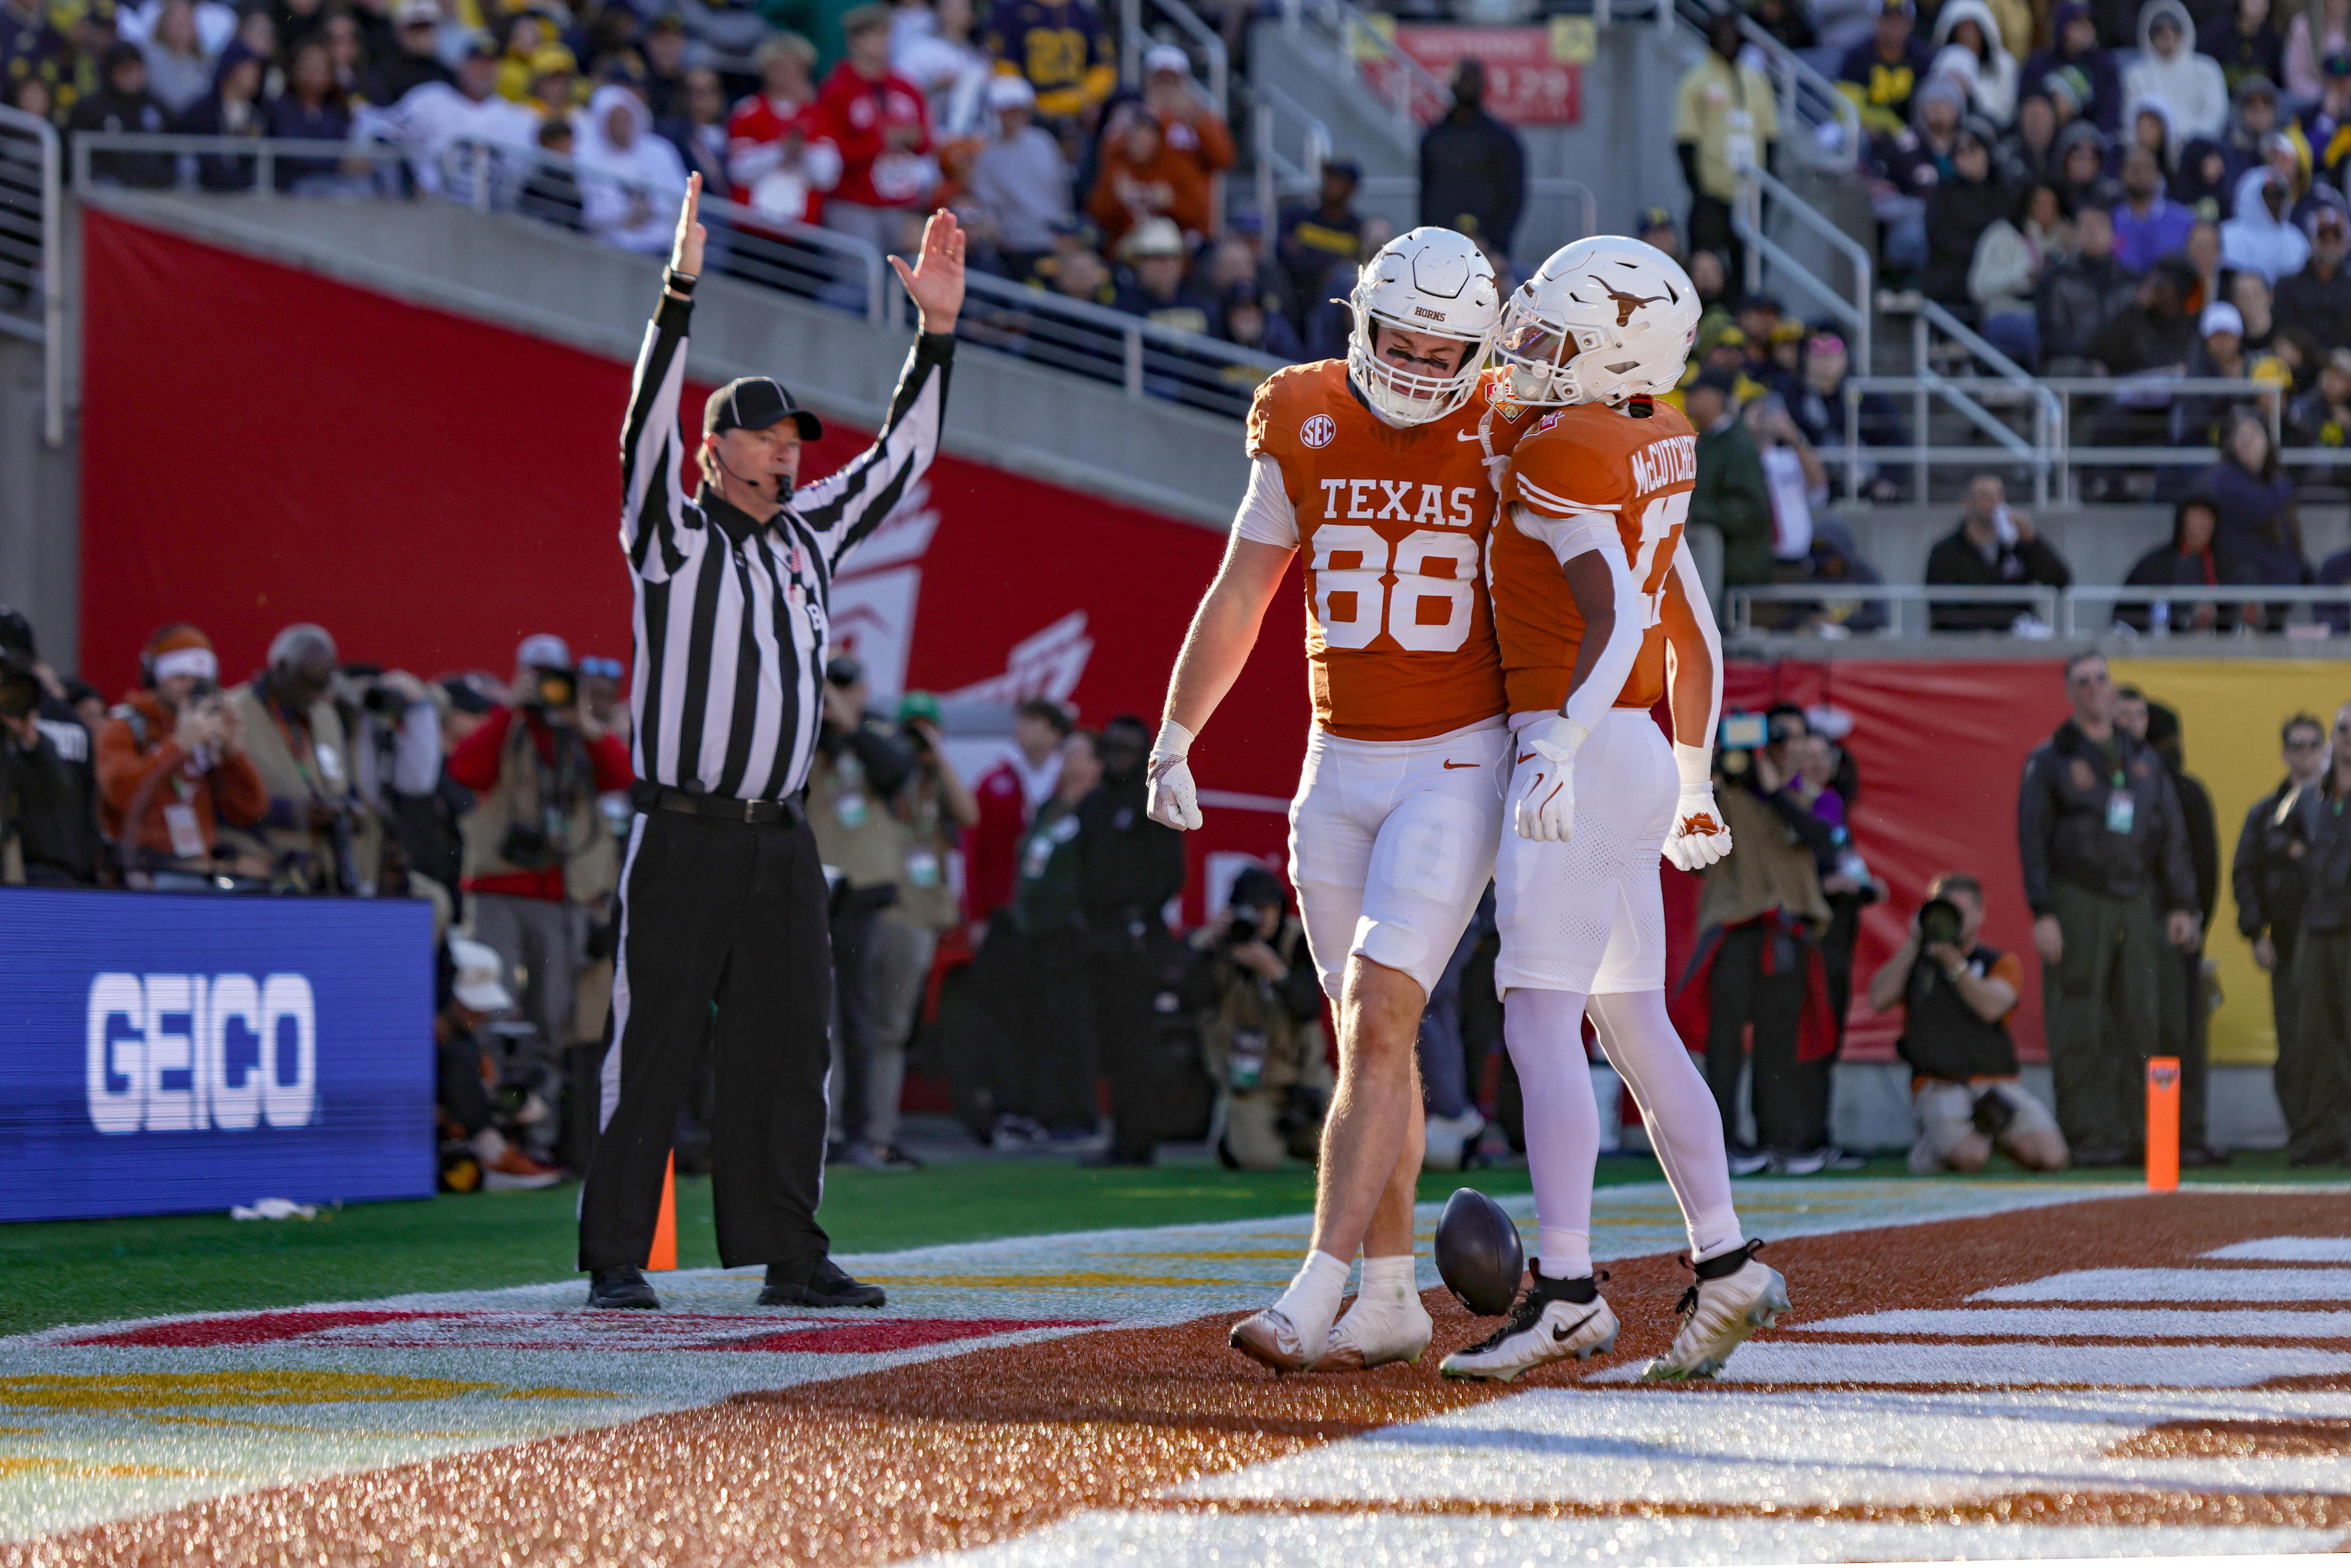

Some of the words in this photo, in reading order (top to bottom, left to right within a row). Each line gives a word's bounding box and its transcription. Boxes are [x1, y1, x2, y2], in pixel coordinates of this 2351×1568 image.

[1415, 306, 1446, 322] HORNS
[1302, 416, 1333, 447] SEC
[1320, 479, 1477, 527] TEXAS
[1311, 523, 1480, 652] 88
[1629, 490, 1694, 629] 17
[86, 972, 316, 1135] GEICO
